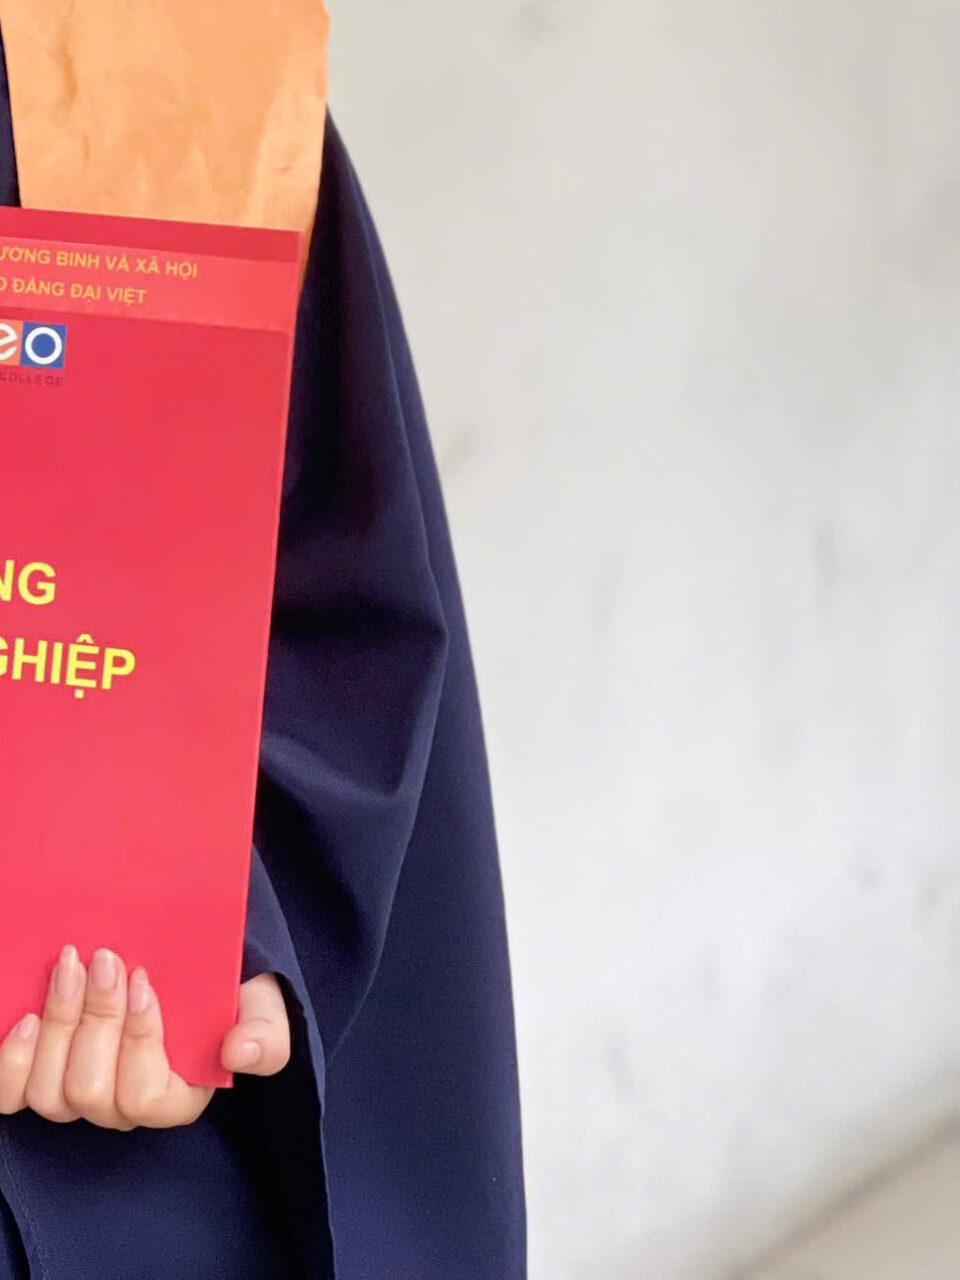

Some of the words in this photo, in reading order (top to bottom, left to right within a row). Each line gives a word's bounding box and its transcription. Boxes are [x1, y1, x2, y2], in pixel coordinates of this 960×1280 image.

[56, 250, 100, 269] BINH
[105, 253, 130, 272] VÀ
[135, 256, 159, 274] XÃ
[70, 283, 101, 303] ĐẠI
